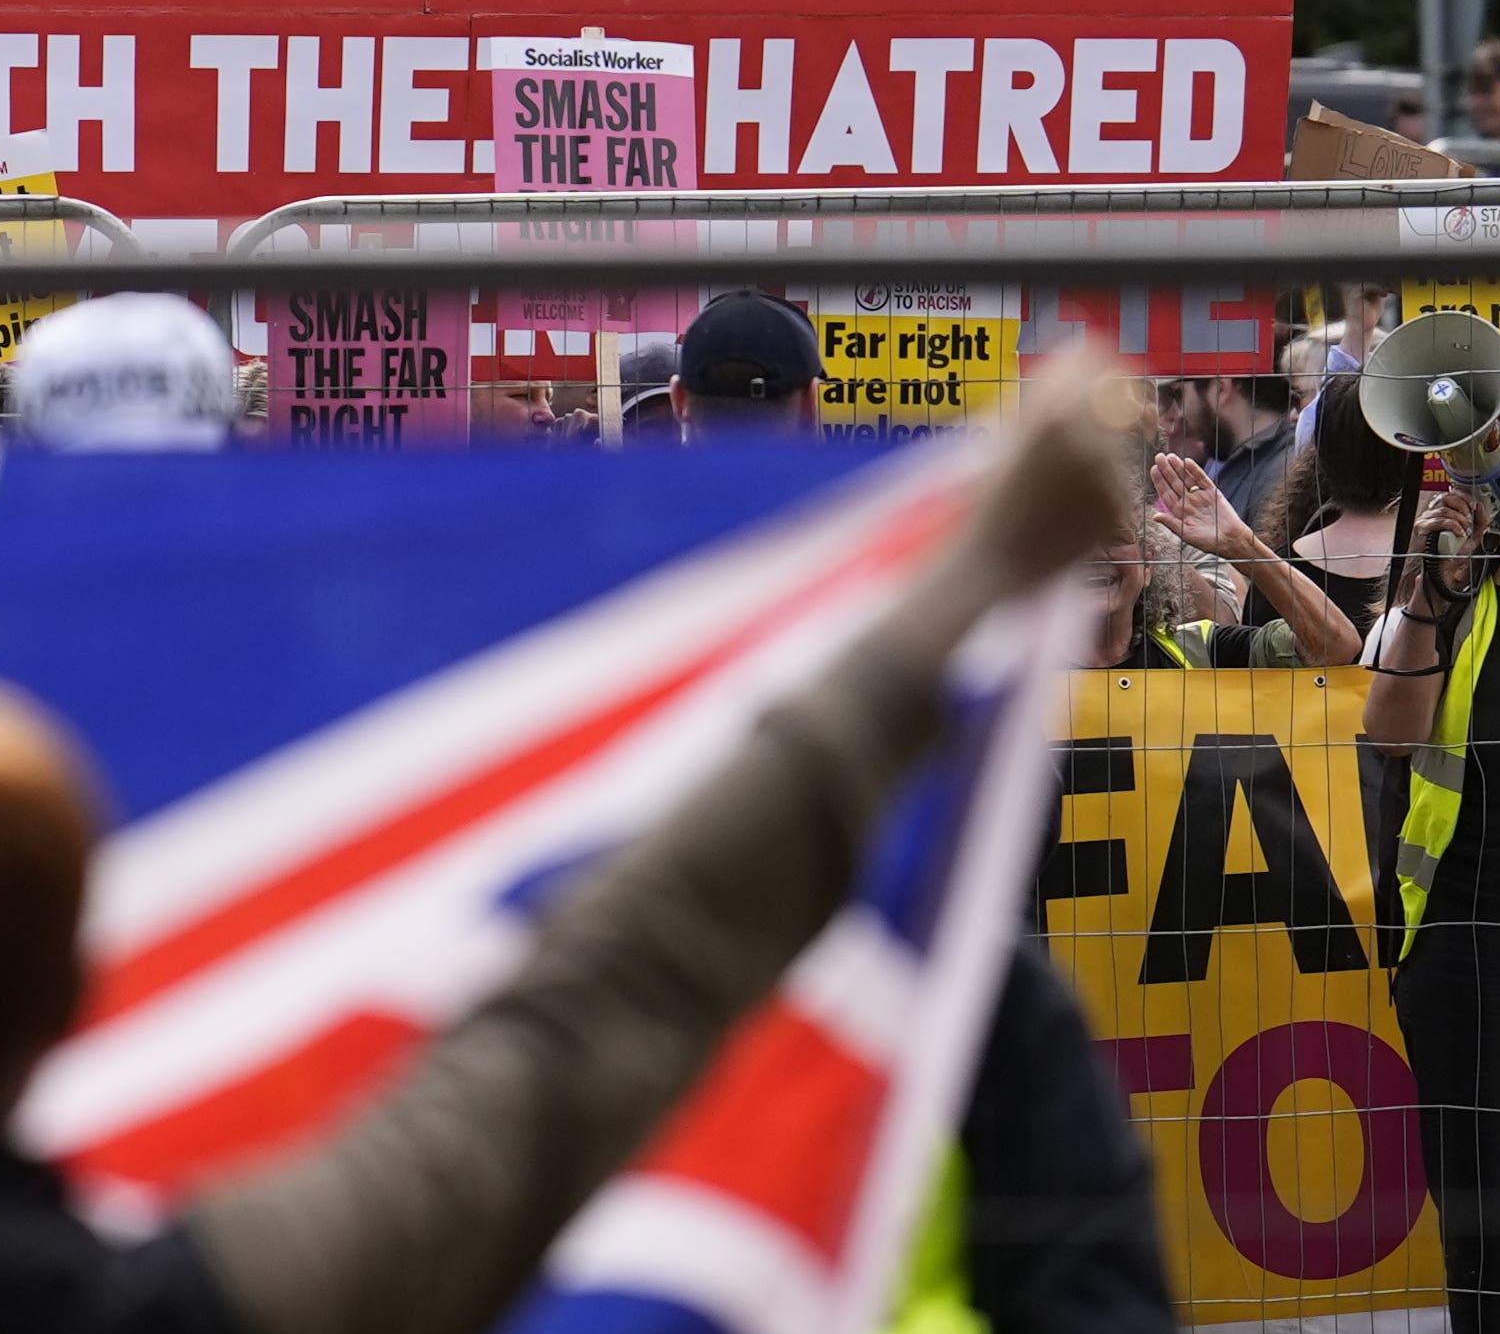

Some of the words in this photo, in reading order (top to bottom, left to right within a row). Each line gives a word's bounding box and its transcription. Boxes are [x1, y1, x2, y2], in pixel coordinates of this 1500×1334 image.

[515, 78, 656, 132] SMASH
[704, 38, 1247, 174] HATRED
[514, 134, 592, 185] THE
[607, 137, 678, 189] FAR
[1481, 224, 1500, 238] TO
[289, 290, 427, 343] SMASH
[523, 303, 585, 321] WELCOME
[894, 295, 913, 310] TO
[917, 295, 972, 311] RACISM
[824, 323, 886, 360] Far
[899, 322, 990, 367] right
[288, 348, 365, 399] THE
[382, 348, 447, 399] FAR
[823, 377, 887, 405] are
[900, 372, 961, 406] not
